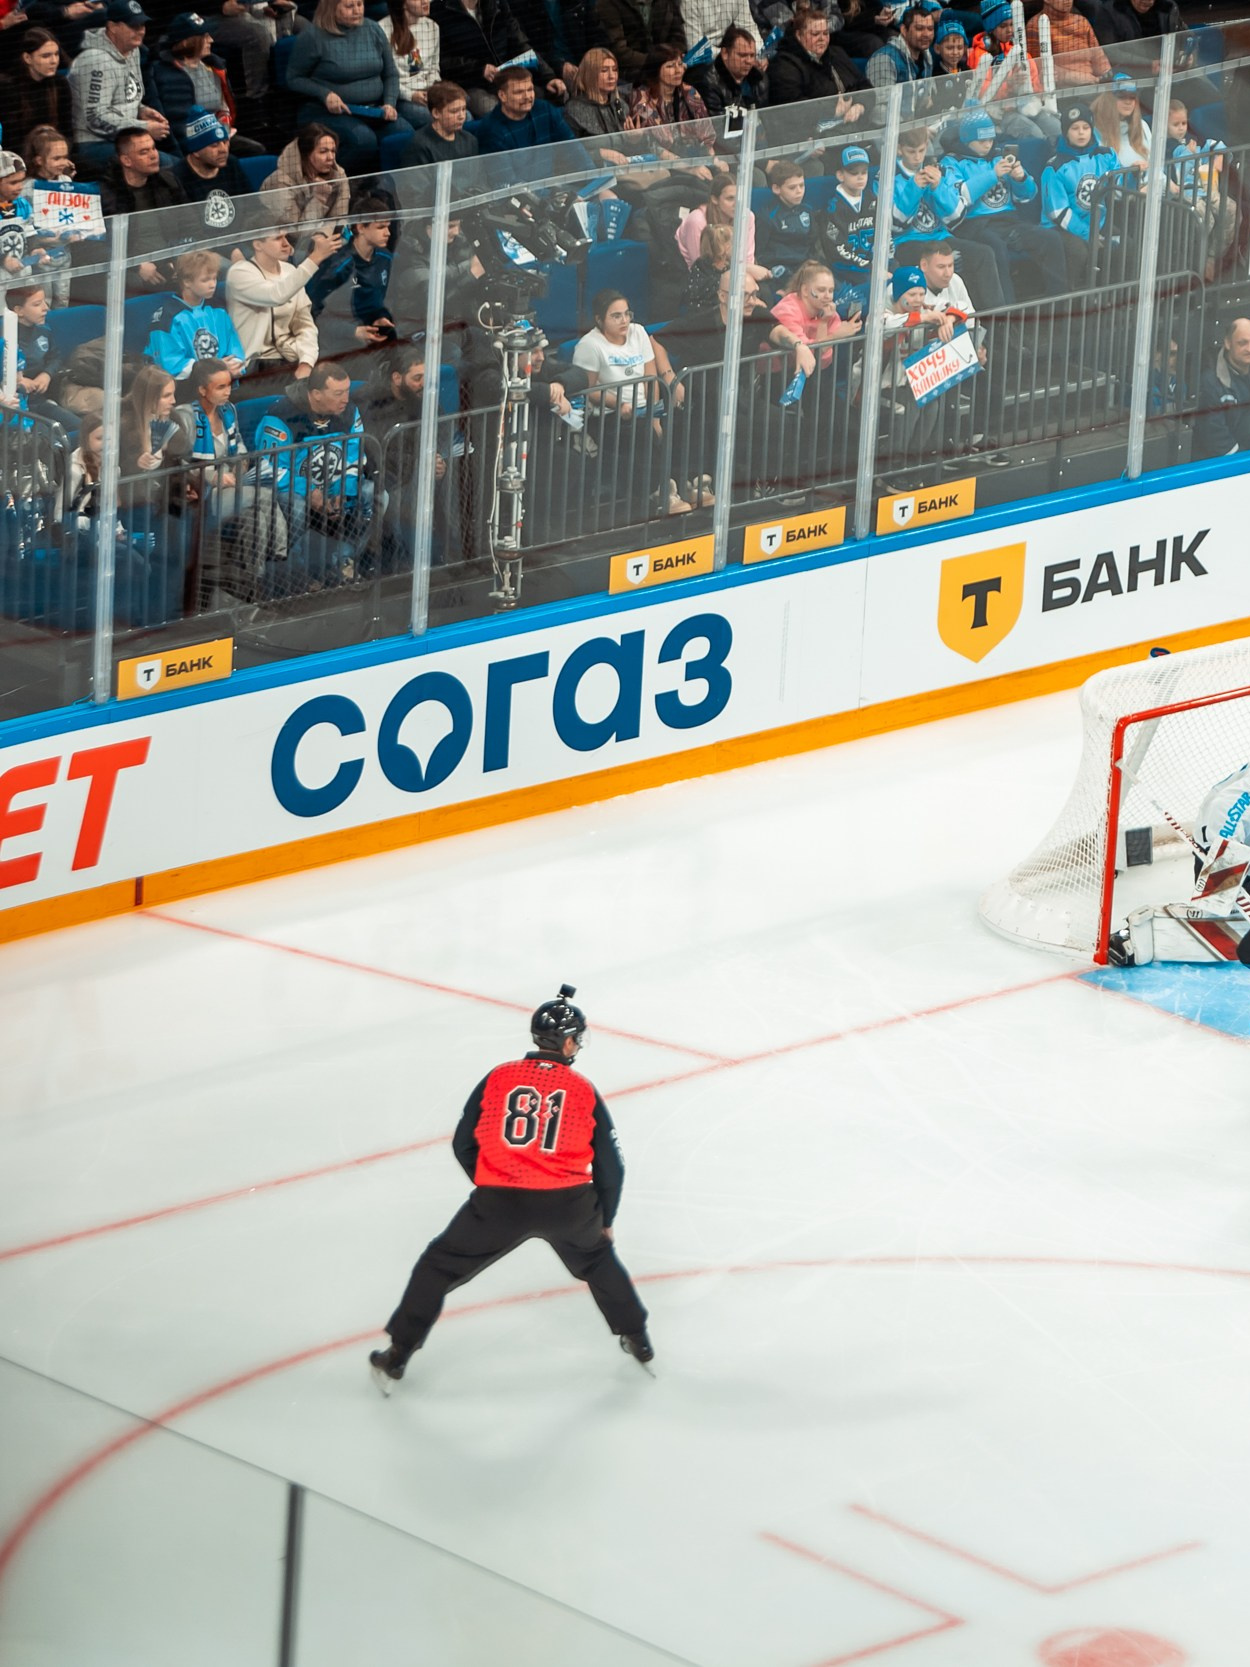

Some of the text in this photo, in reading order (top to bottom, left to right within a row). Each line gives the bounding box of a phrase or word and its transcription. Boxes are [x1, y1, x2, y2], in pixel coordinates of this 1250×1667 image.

[88, 70, 103, 105] SIBIR
[908, 348, 947, 383] ХОЧУ
[917, 494, 958, 514] БАНК
[785, 523, 828, 543] БАНК
[652, 551, 697, 573] БАНК
[1042, 528, 1211, 613] БАНК
[165, 655, 213, 678] БАНК
[503, 1085, 567, 1154] 81
